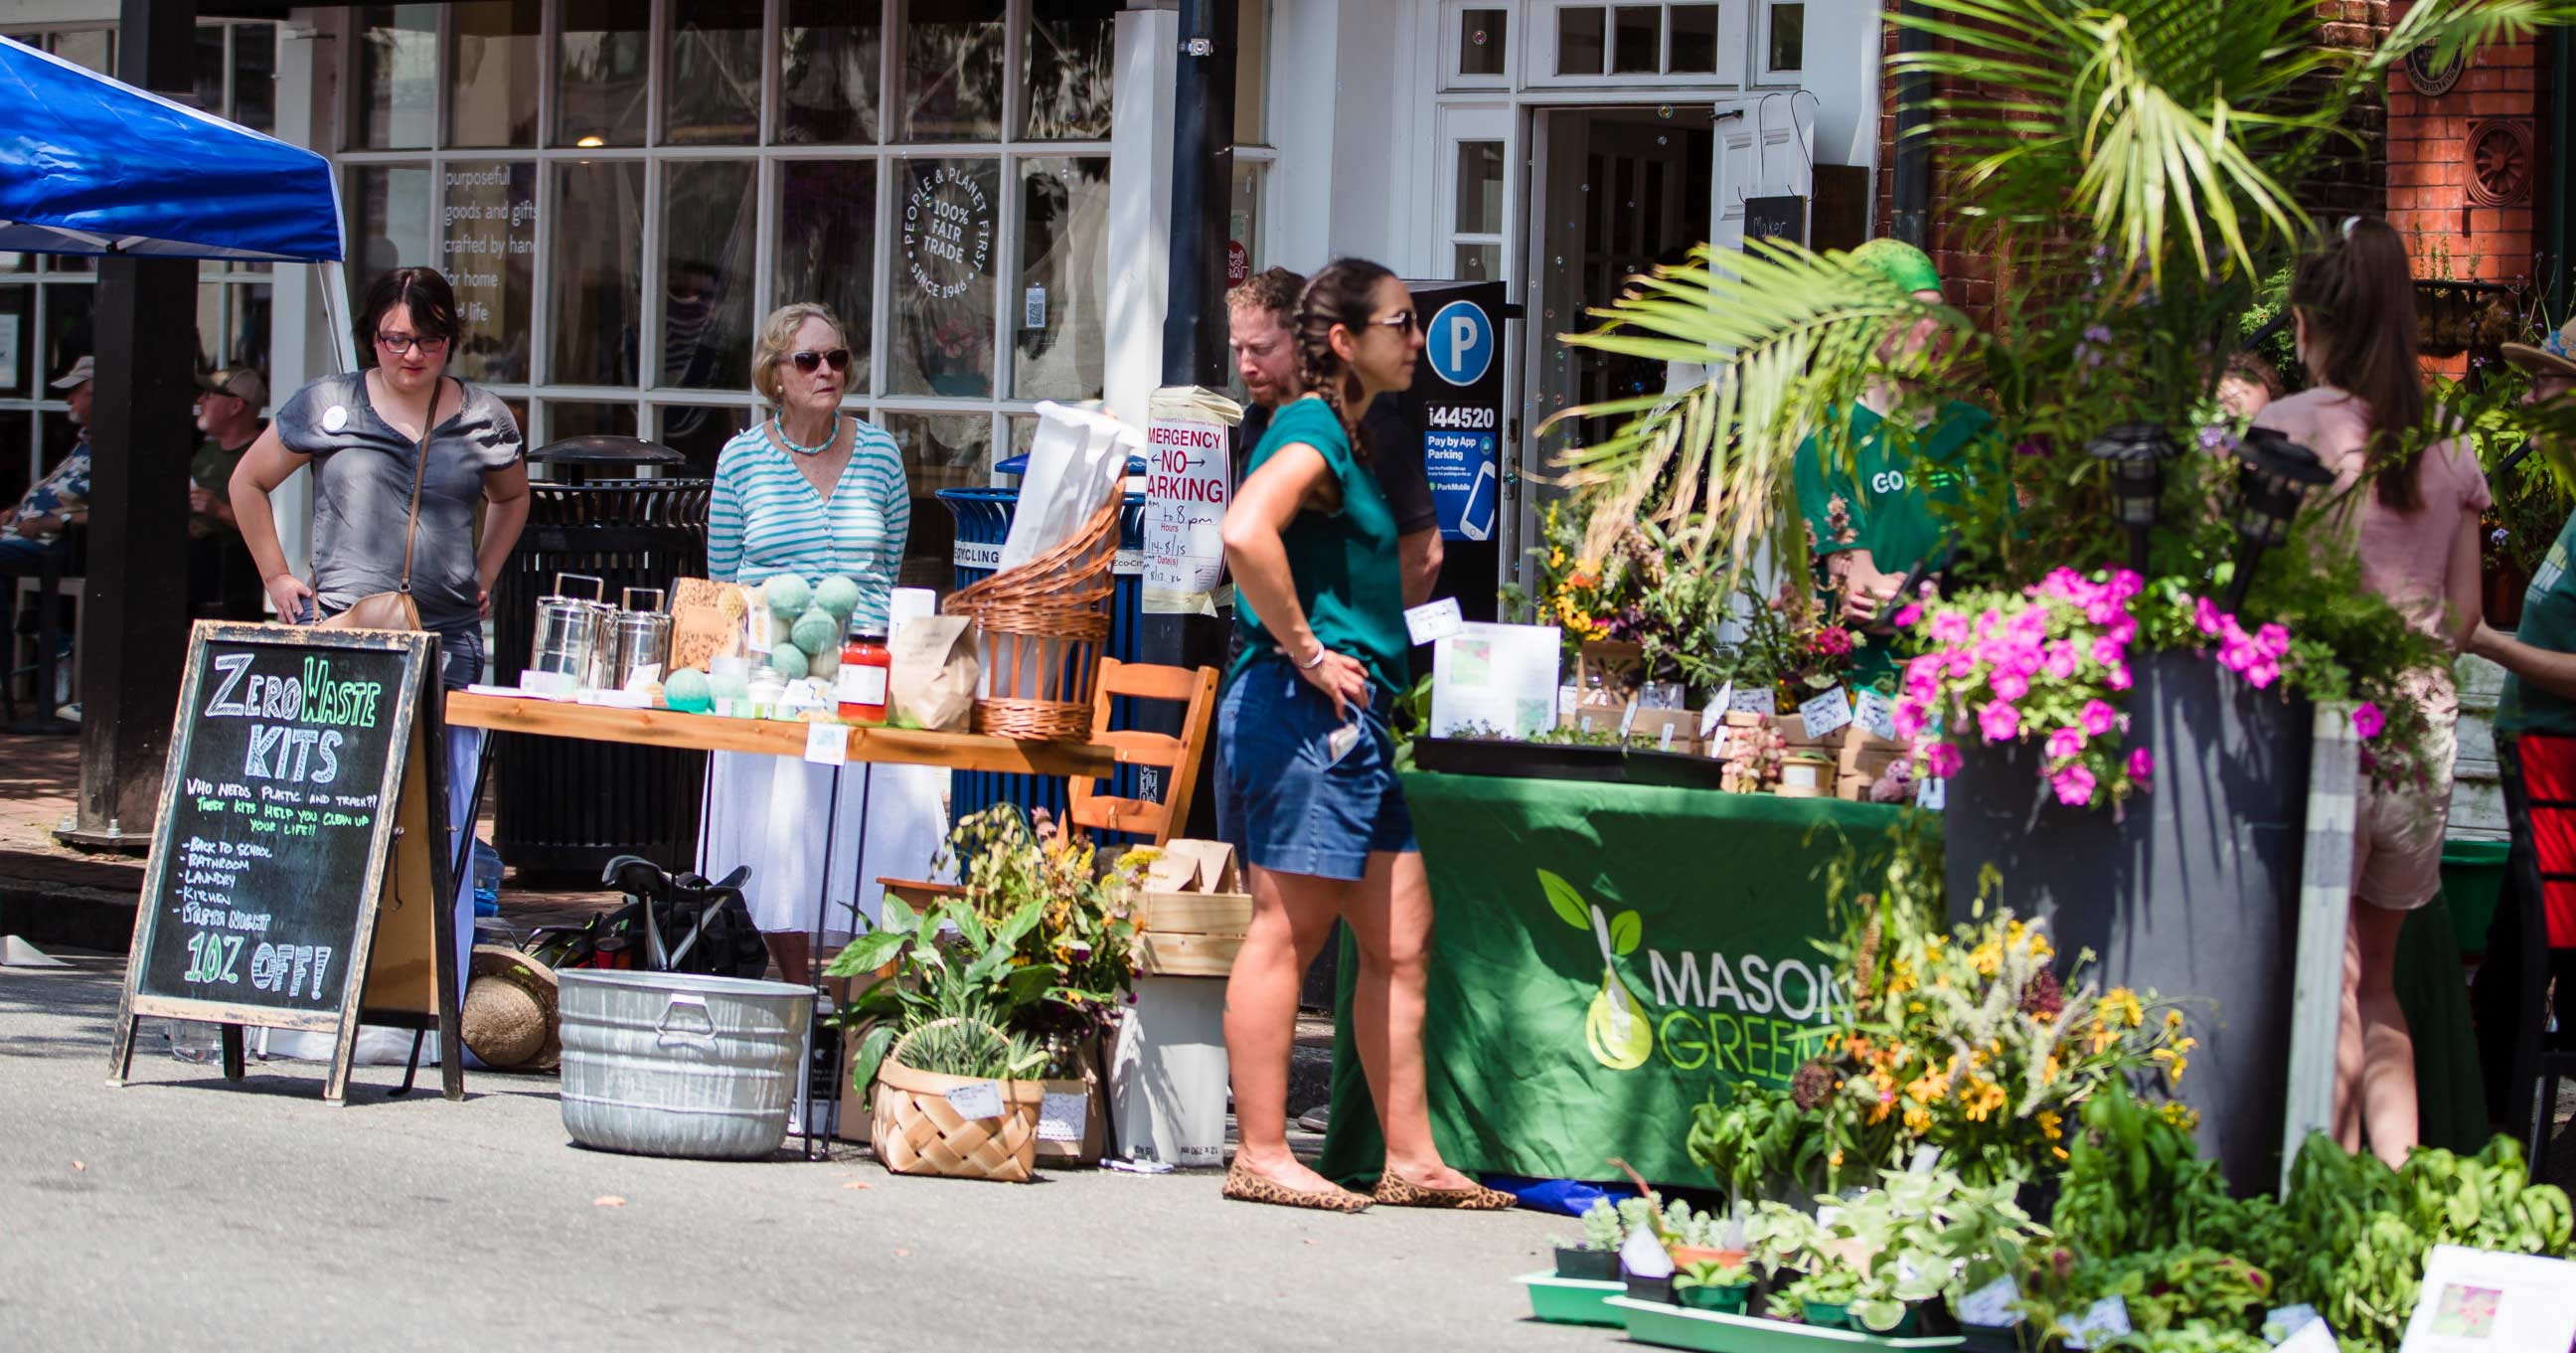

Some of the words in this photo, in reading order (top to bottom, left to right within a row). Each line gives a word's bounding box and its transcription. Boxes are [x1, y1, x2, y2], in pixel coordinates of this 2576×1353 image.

[446, 165, 511, 191] purposeful
[445, 201, 482, 227] goods
[486, 201, 509, 220] and
[512, 201, 539, 227] gifts
[904, 177, 933, 245] PEOPLE
[935, 169, 944, 184] &
[948, 167, 987, 213] PLANET
[973, 220, 990, 271] FIRST
[934, 200, 970, 226] 100%
[932, 219, 962, 244] FAIR
[445, 234, 487, 254] crafted
[491, 235, 505, 259] by
[924, 236, 965, 264] TRADE
[464, 268, 498, 287] home
[911, 262, 939, 297] SINCE
[942, 280, 967, 299] 1946
[469, 302, 489, 321] life
[1451, 317, 1478, 372] P
[1148, 426, 1220, 449] MERGENCY
[1428, 435, 1446, 447] Pay
[1447, 435, 1459, 447] by
[1460, 436, 1476, 447] App
[1161, 449, 1188, 474] NO
[1428, 448, 1464, 461] Parking
[1147, 474, 1223, 503] ARKING
[1161, 523, 1179, 532] Hours
[1177, 505, 1186, 524] 8
[1188, 516, 1212, 532] pm
[954, 548, 1000, 564] ECYCLING
[1158, 556, 1178, 568] Date(s)
[301, 655, 382, 728] WASTE
[244, 724, 343, 784] KITS
[186, 778, 213, 796] WHO
[218, 782, 251, 798] NEEDS
[261, 785, 301, 803] PLASTIC
[309, 794, 330, 805] AND
[234, 798, 256, 814] KITS
[264, 804, 294, 821] HELP
[298, 809, 318, 823] YOU
[323, 812, 352, 827] CLEAN
[356, 815, 370, 828] UP
[249, 818, 276, 833] YOUR
[219, 841, 234, 854] TO
[237, 842, 273, 858] SCHOOL
[184, 930, 244, 984] 10%
[251, 941, 332, 1001] OFF!
[1648, 948, 1854, 1025] MASON
